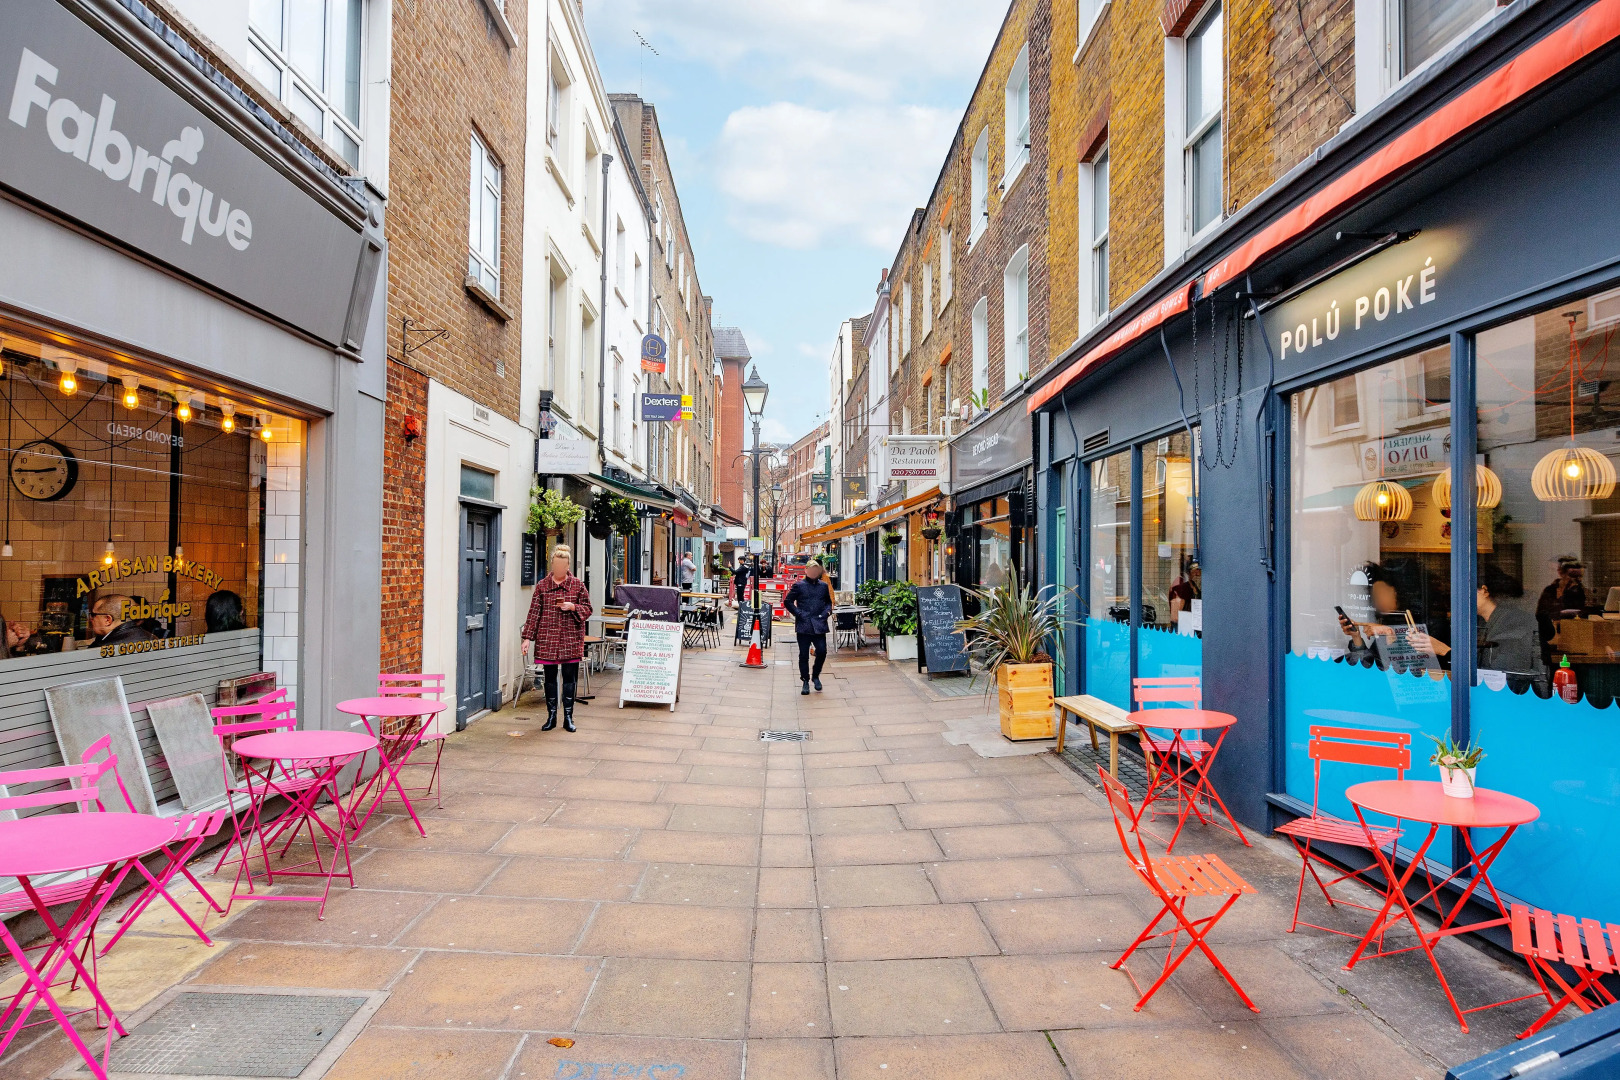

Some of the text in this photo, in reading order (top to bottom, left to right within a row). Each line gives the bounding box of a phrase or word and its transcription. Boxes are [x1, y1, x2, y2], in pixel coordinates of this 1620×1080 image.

[8, 47, 252, 250] Fabrique
[1280, 256, 1436, 361] POLÚ POKÉ
[644, 396, 679, 407] Dexters
[890, 445, 937, 456] Da Paolo
[890, 457, 936, 465] Restaurant
[76, 555, 224, 599] ARTISAN BAKERY
[120, 589, 191, 624] Fabrique
[632, 622, 664, 630] SALUMERIA
[100, 633, 205, 658] 53 GOODGE STREET
